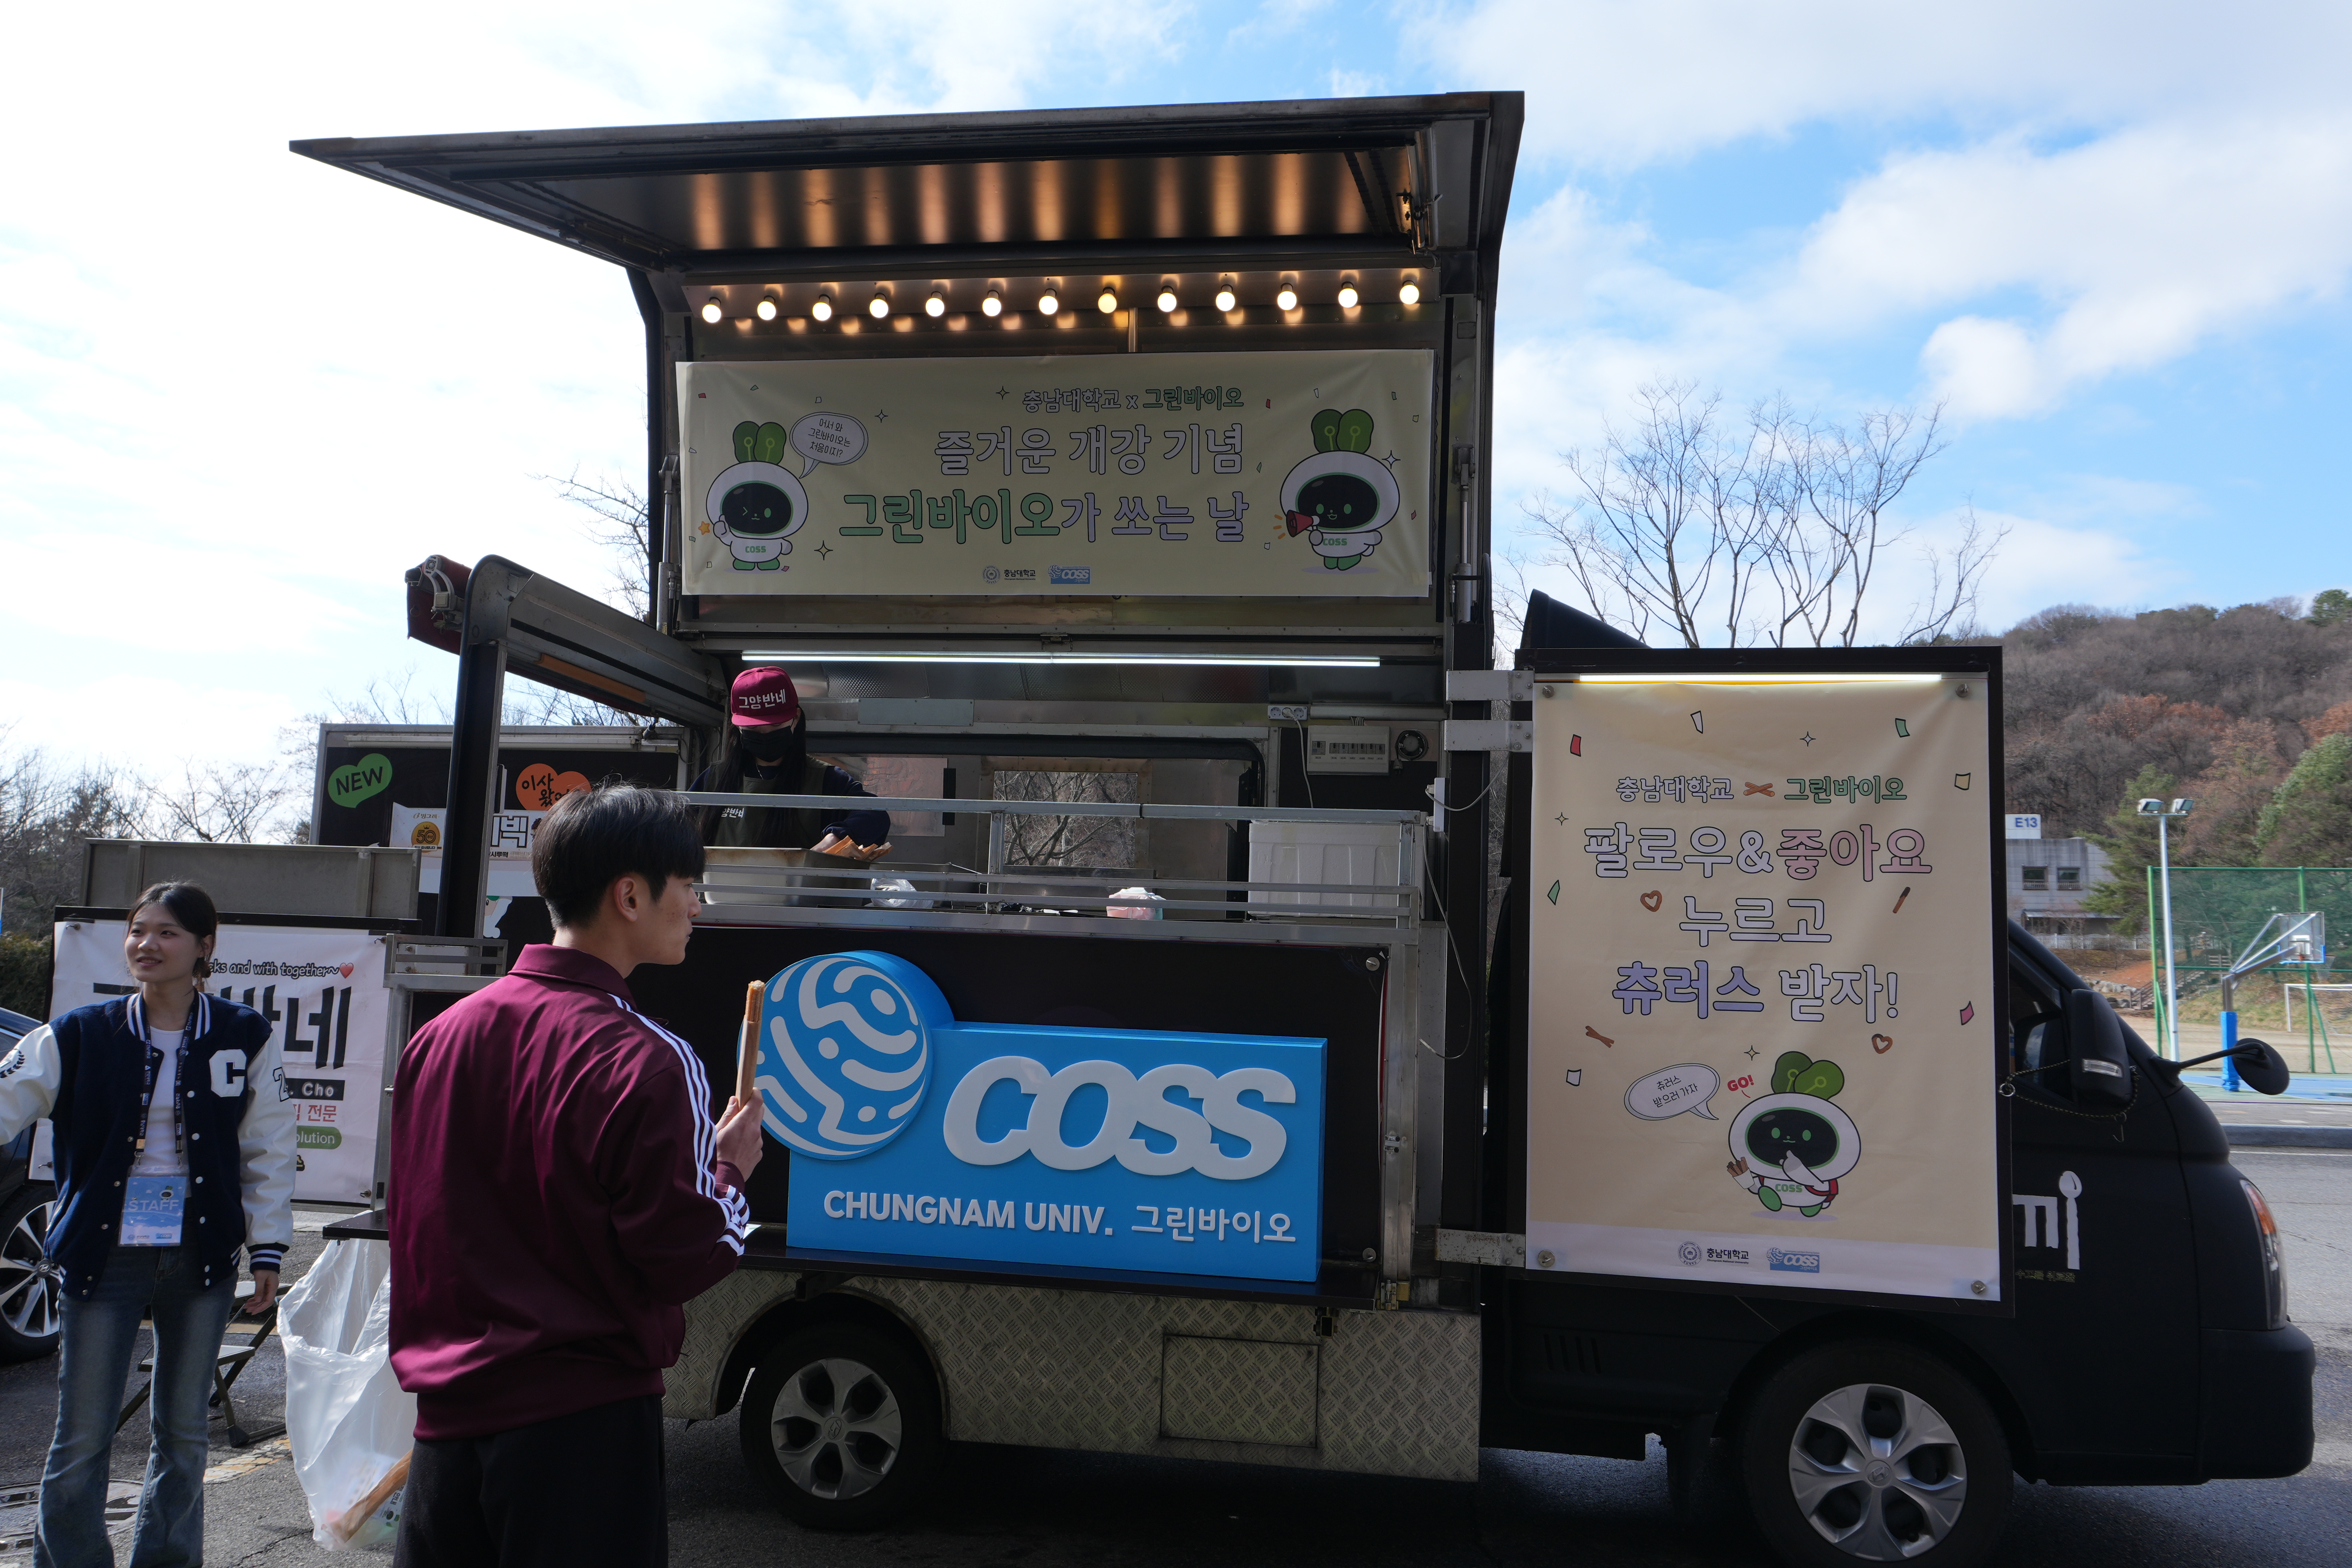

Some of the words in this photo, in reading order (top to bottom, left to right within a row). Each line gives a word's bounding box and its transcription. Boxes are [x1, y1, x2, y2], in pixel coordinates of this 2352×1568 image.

[1022, 388, 1122, 413] 충남대학교
[1142, 386, 1244, 411] 그린바이오
[819, 418, 834, 431] 어서
[836, 422, 843, 432] 와
[808, 427, 851, 447] 그린바이오는
[809, 440, 843, 458] 처음이지?
[934, 426, 1056, 476] 즐거운
[1069, 424, 1152, 476] 개강
[1163, 423, 1243, 474] 기념
[838, 488, 1101, 544] 그린바이오가
[1111, 495, 1195, 541] 쏘는
[1207, 491, 1250, 543] 날
[1004, 569, 1036, 577] 충남대학교
[1061, 569, 1089, 579] COSS
[738, 689, 786, 710] 그양반네
[335, 767, 384, 795] NEW
[522, 773, 554, 790] 이사
[1615, 775, 1735, 803] 충남대학교
[1783, 775, 1908, 805] 그린바이오
[490, 816, 529, 848] 빅
[2015, 817, 2038, 828] E13
[416, 830, 436, 844] 50
[1583, 822, 1933, 882] 팔로우&좋아요
[1679, 896, 1833, 947] 누르고
[229, 959, 251, 974] and
[253, 962, 278, 976] with
[1611, 960, 1765, 1020] 츄러스
[1778, 962, 1899, 1024] 받자!
[209, 1049, 247, 1098] C
[302, 1081, 335, 1097] Cho
[1656, 1075, 1682, 1092] 츄러스
[1727, 1075, 1755, 1092] GO!
[1652, 1090, 1681, 1108] 받으러
[1681, 1083, 1698, 1099] 가자
[308, 1105, 337, 1122] 전문
[942, 1055, 1297, 1181] COSS
[1775, 1183, 1803, 1193] COSS
[128, 1200, 180, 1211] STAFF
[823, 1189, 1016, 1230] CHUNGNAM
[1024, 1201, 1114, 1236] UNIV.
[1131, 1204, 1296, 1244] 그린바이오
[1707, 1248, 1749, 1260] 충남대학교
[1784, 1254, 1819, 1267] COSS
